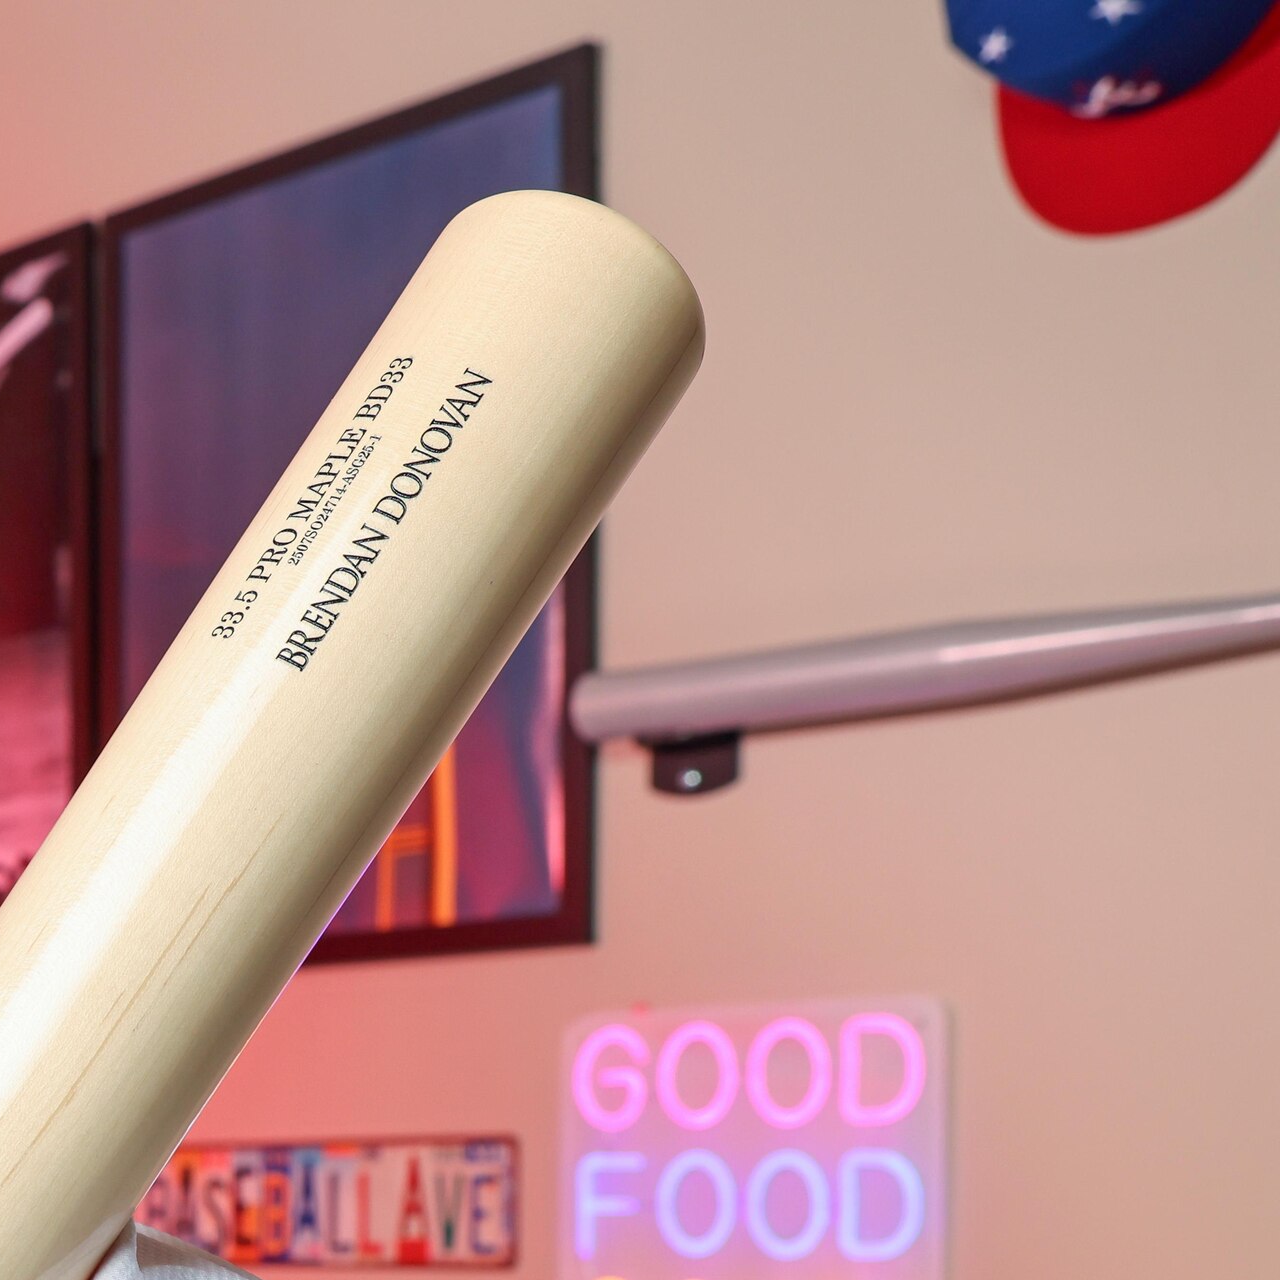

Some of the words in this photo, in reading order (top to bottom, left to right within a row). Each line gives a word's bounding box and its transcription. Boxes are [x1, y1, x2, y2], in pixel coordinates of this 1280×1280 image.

[211, 590, 258, 639] 33.5
[246, 527, 298, 583] PRO
[286, 427, 367, 522] MAPLE
[353, 356, 414, 421] BD33
[275, 523, 390, 671] BRENDAN
[372, 367, 493, 525] DONOVAN
[571, 1012, 927, 1131] GOOD
[397, 1156, 498, 1262] AVE
[573, 1148, 926, 1263] FOOD
